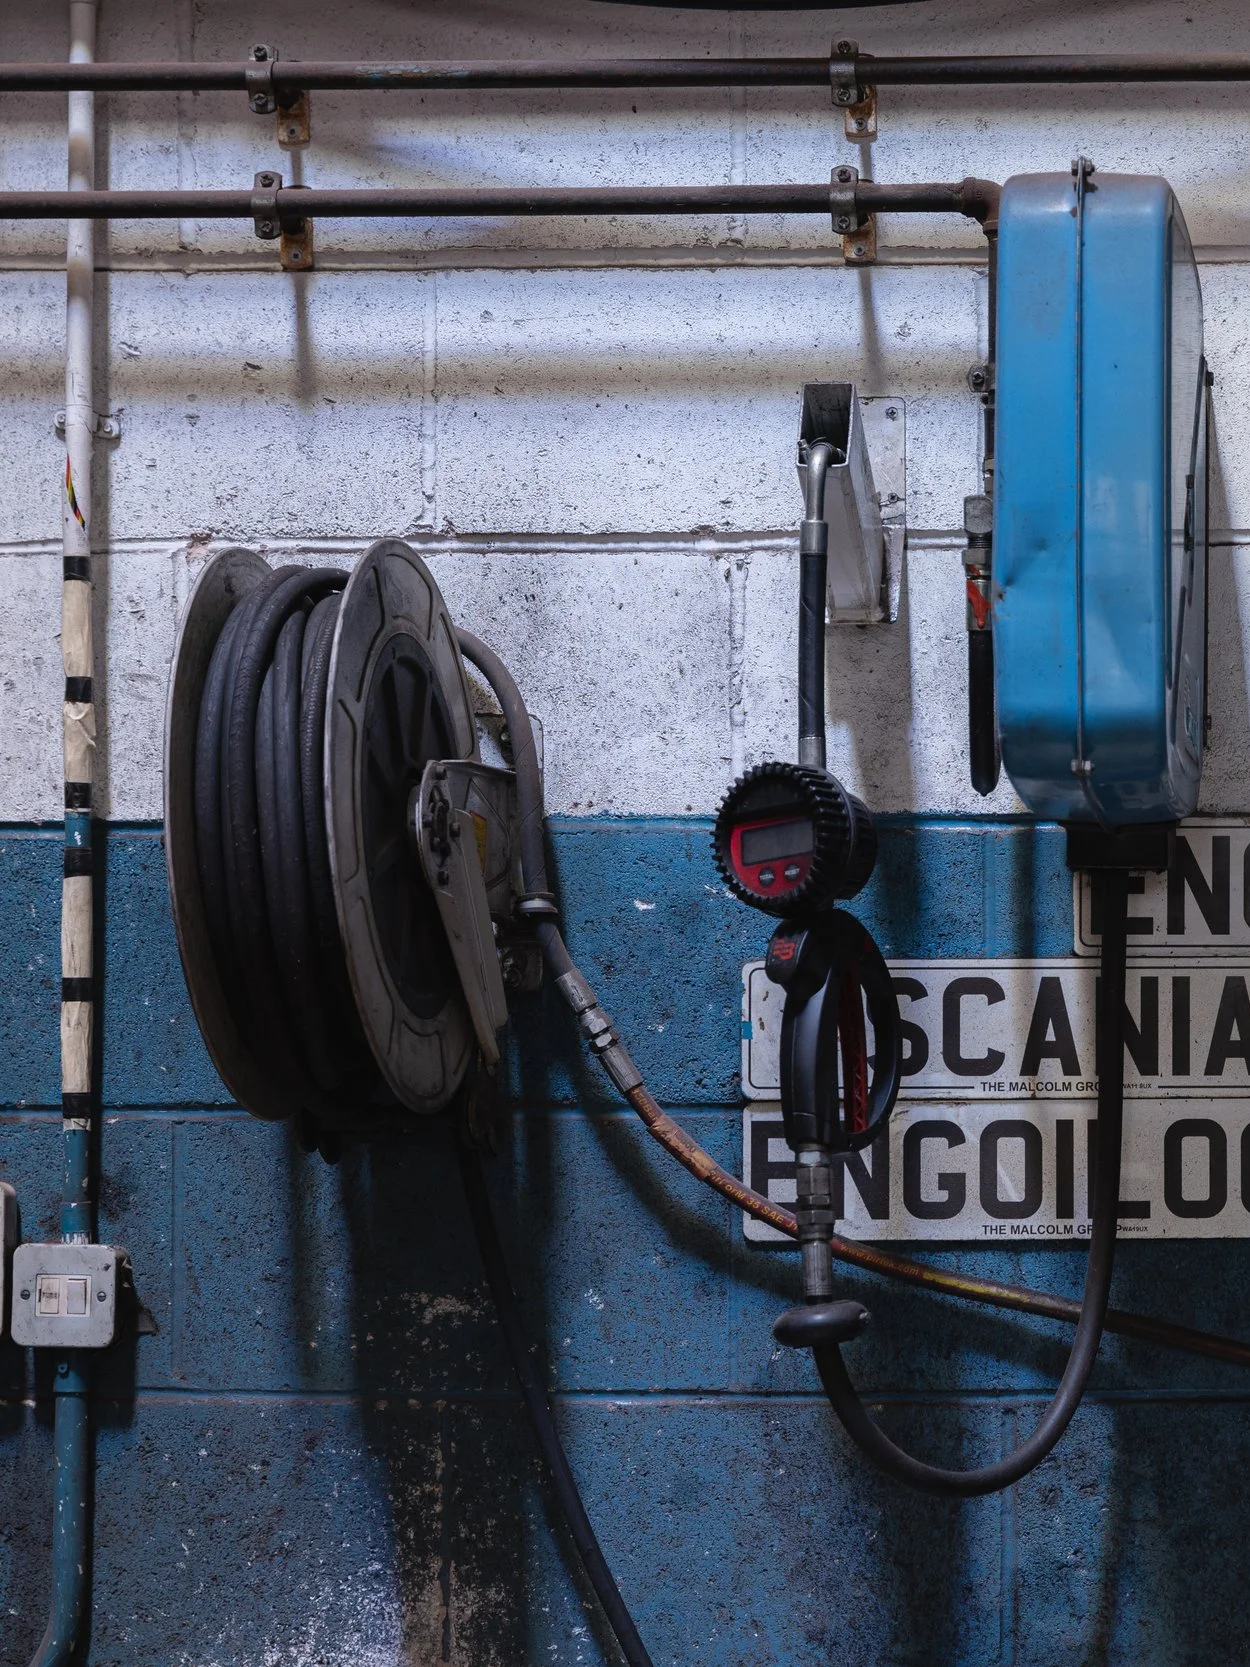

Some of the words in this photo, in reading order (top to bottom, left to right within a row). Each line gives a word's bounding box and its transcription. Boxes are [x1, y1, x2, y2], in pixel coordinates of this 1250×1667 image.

[759, 873, 774, 881] TOTAL
[784, 867, 800, 876] RESET
[980, 1081, 1005, 1092] THE
[1009, 1081, 1072, 1092] MALCOLM
[746, 1197, 761, 1209] 35
[761, 1206, 784, 1223] SAE
[982, 1224, 1002, 1235] THE
[1010, 1224, 1073, 1235] MALCOLM
